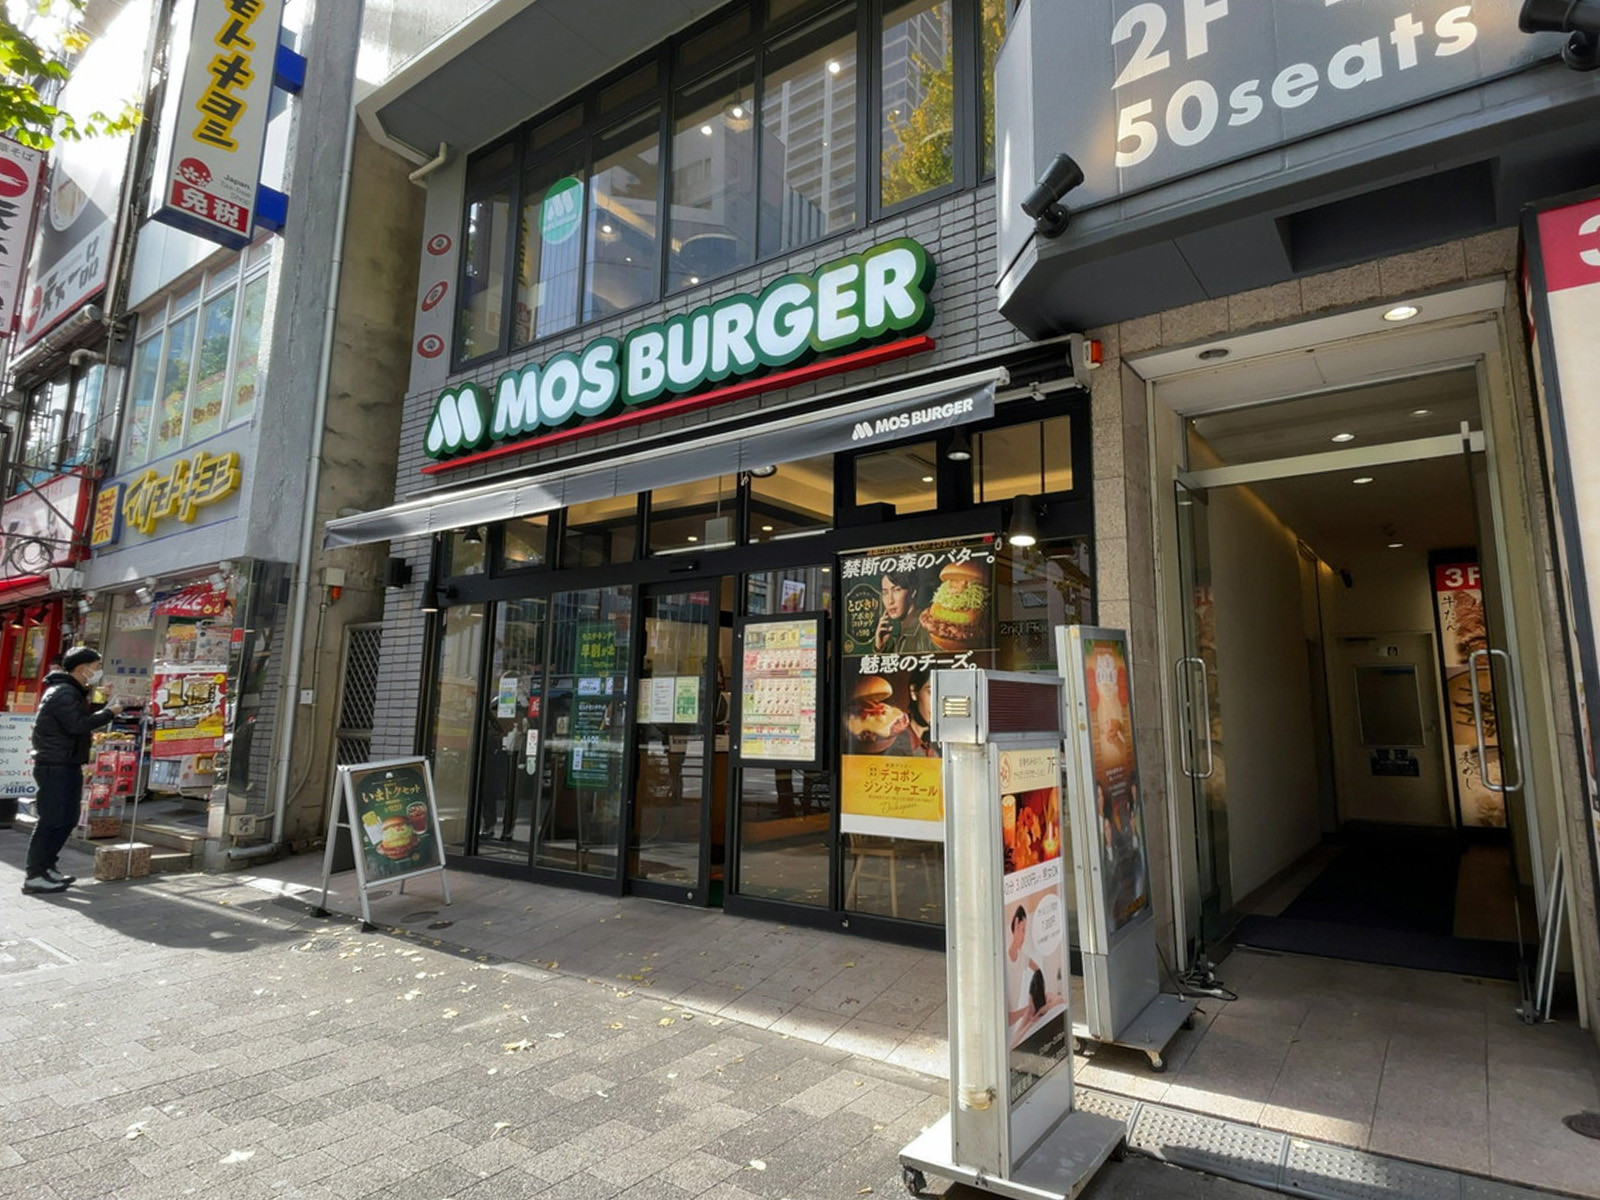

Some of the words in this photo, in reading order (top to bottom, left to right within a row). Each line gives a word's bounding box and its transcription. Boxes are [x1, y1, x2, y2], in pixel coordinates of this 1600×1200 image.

[1110, 0, 1229, 90] 2F
[1115, 5, 1478, 168] 50seats
[181, 187, 239, 229] 免税
[493, 344, 615, 434] MOS
[627, 247, 918, 398] BURGER
[875, 414, 911, 435] MOS
[910, 398, 974, 427] BURGER
[842, 547, 995, 579] 禁断の森のバター。
[1444, 566, 1480, 588] 3F
[859, 650, 979, 675] 魅惑のチーズ。
[5, 785, 36, 795] HIRO
[864, 781, 938, 797] ジンジャーエール
[881, 769, 921, 783] デコポン
